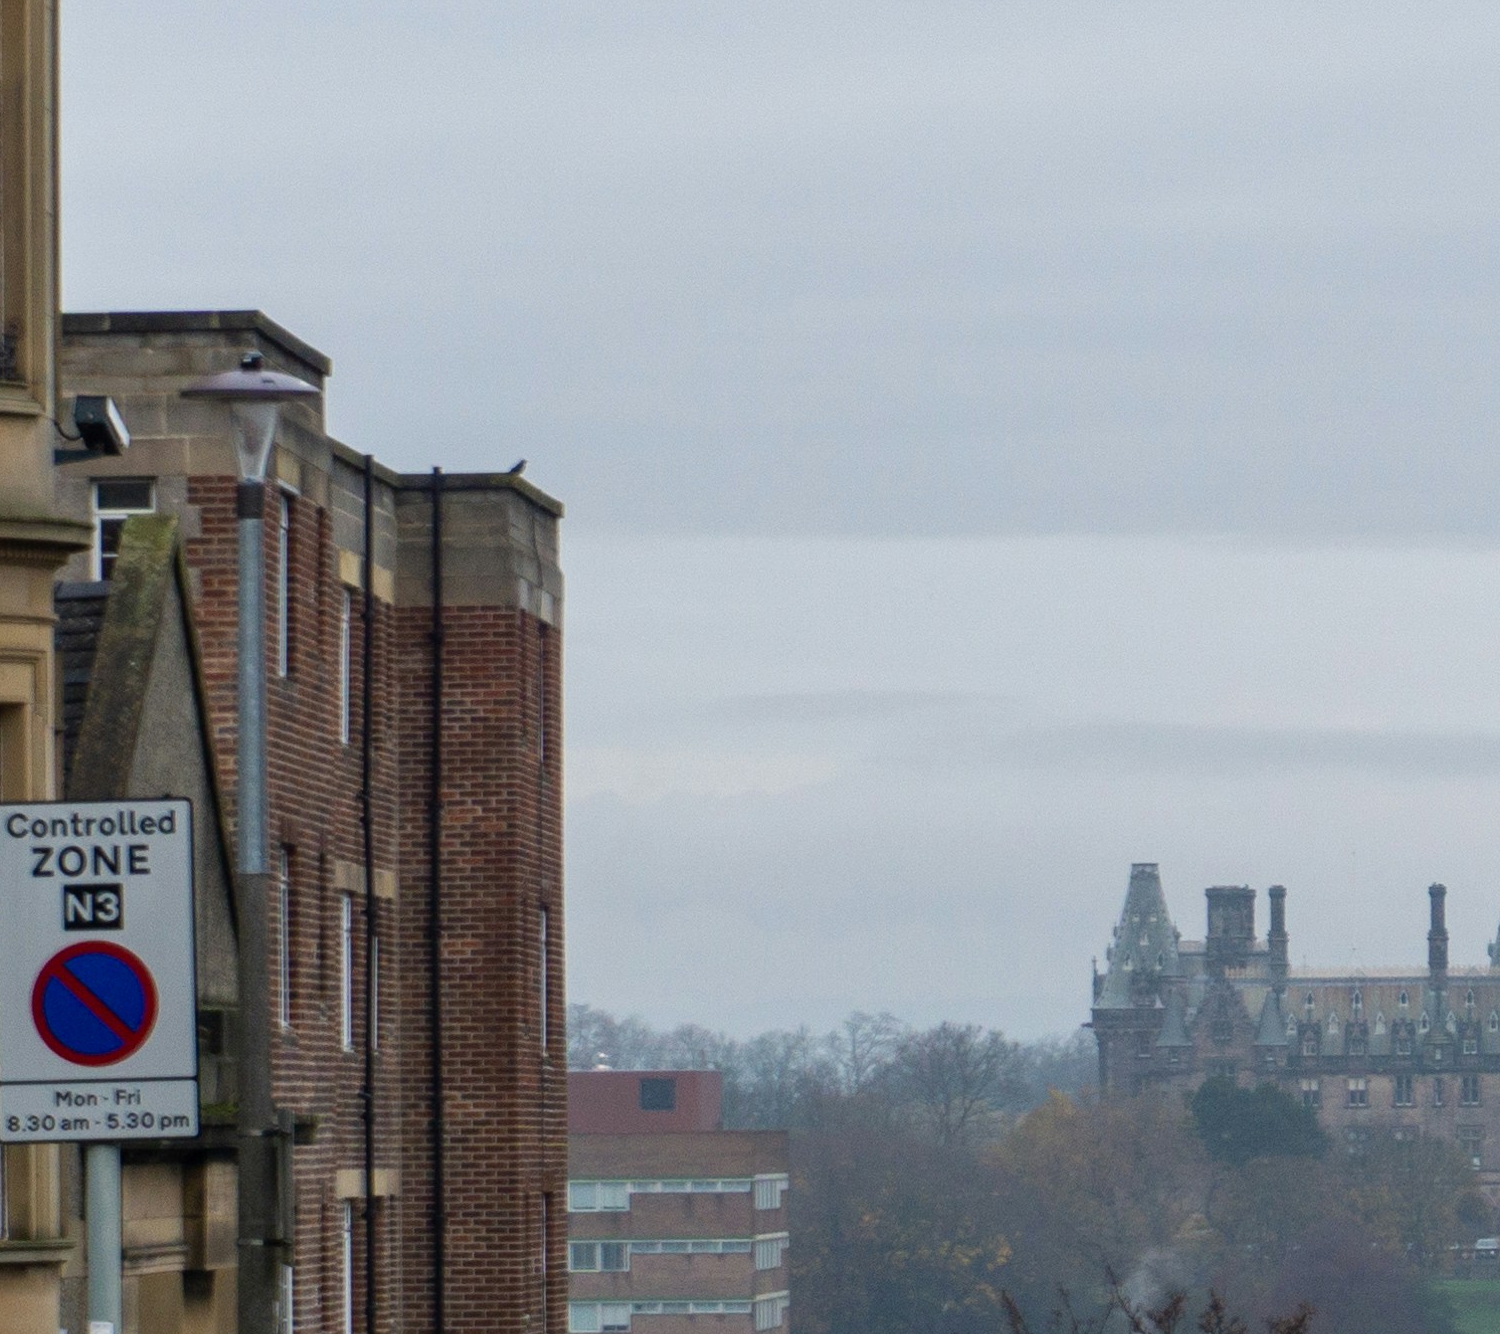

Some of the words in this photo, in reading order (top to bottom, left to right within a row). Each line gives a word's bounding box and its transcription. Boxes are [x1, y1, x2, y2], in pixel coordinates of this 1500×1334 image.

[6, 810, 177, 839] Controlled
[31, 845, 151, 877] ZONE
[65, 893, 120, 923] N3
[54, 1091, 97, 1108] Mon
[115, 1089, 141, 1106] Fri
[7, 1115, 56, 1133] 8.30
[60, 1117, 91, 1132] am
[106, 1112, 155, 1130] 5.30
[160, 1113, 190, 1133] pm
